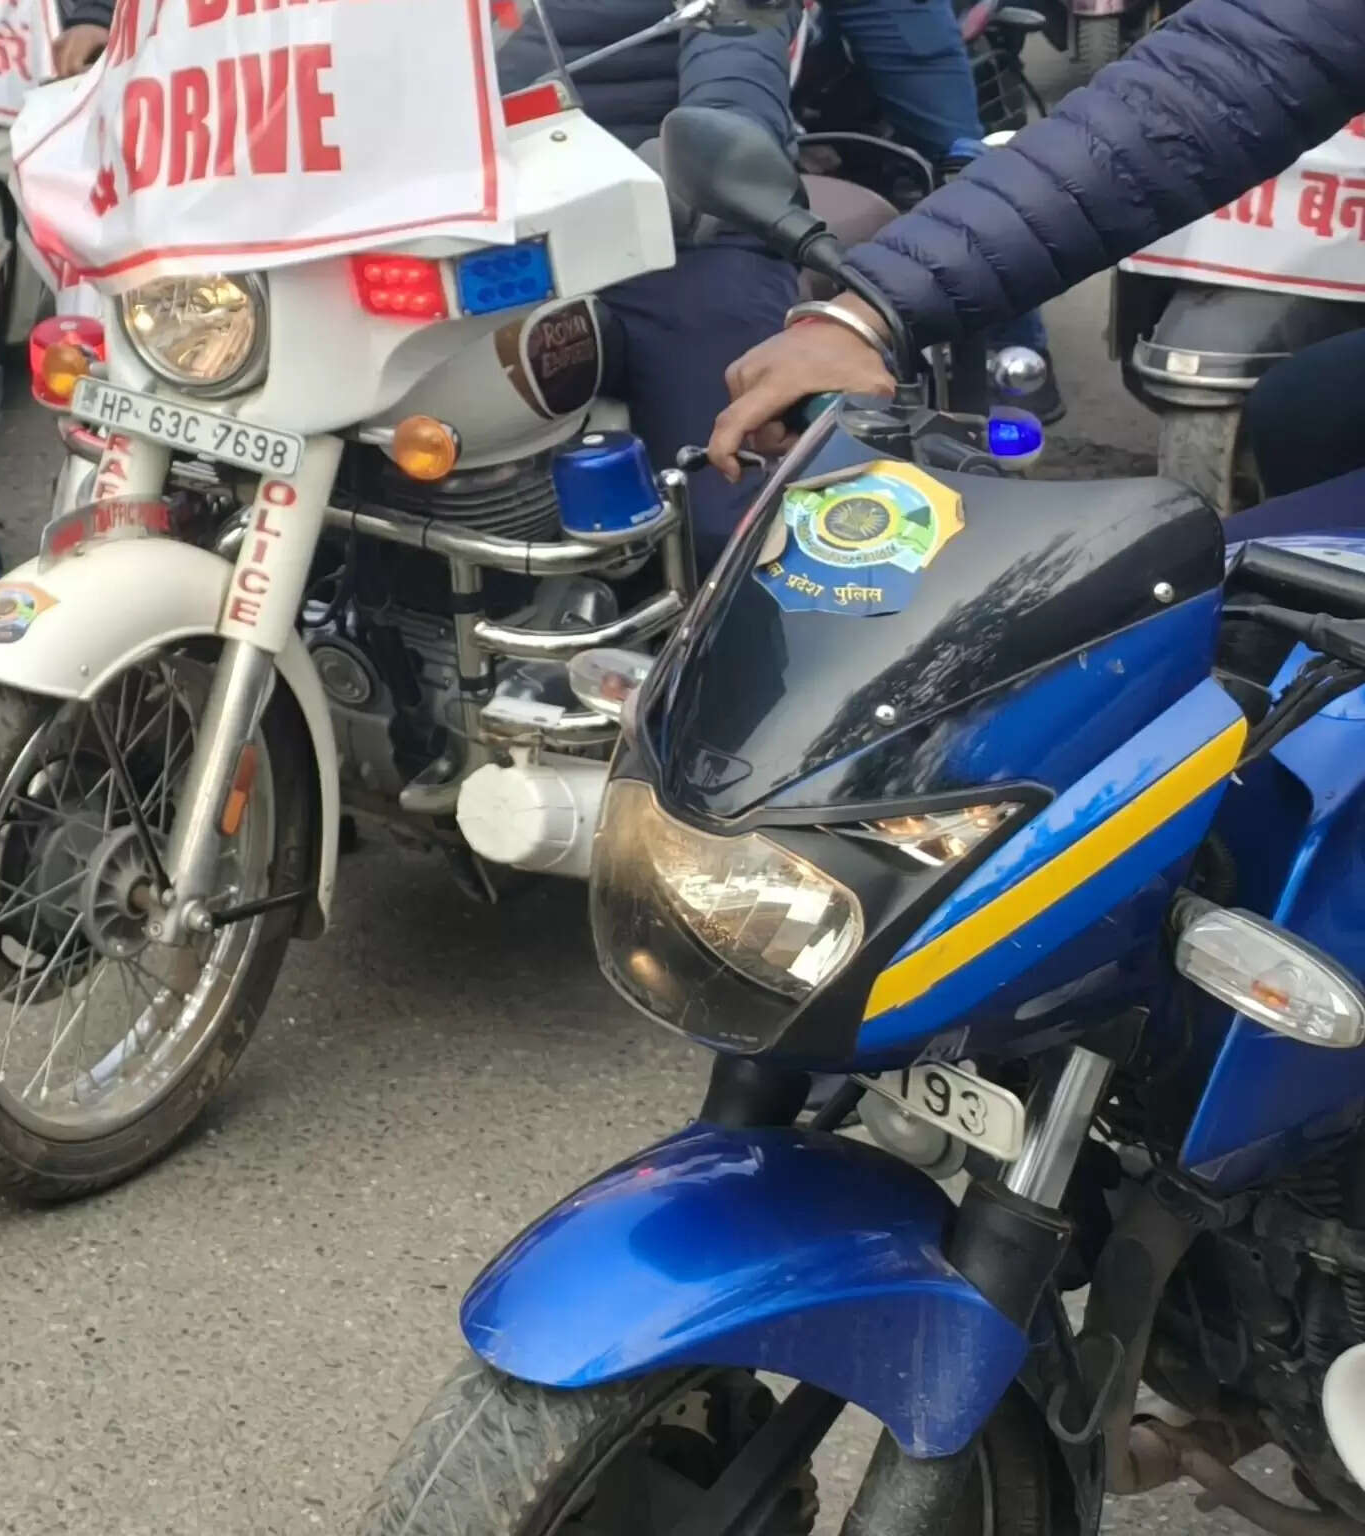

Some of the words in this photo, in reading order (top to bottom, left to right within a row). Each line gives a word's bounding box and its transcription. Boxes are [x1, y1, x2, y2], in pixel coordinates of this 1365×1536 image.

[122, 43, 342, 197] DRIVE
[213, 424, 287, 468] 7698
[229, 479, 297, 626] OLICE
[786, 572, 825, 597] प्रदेश
[833, 581, 882, 605] पुलिस
